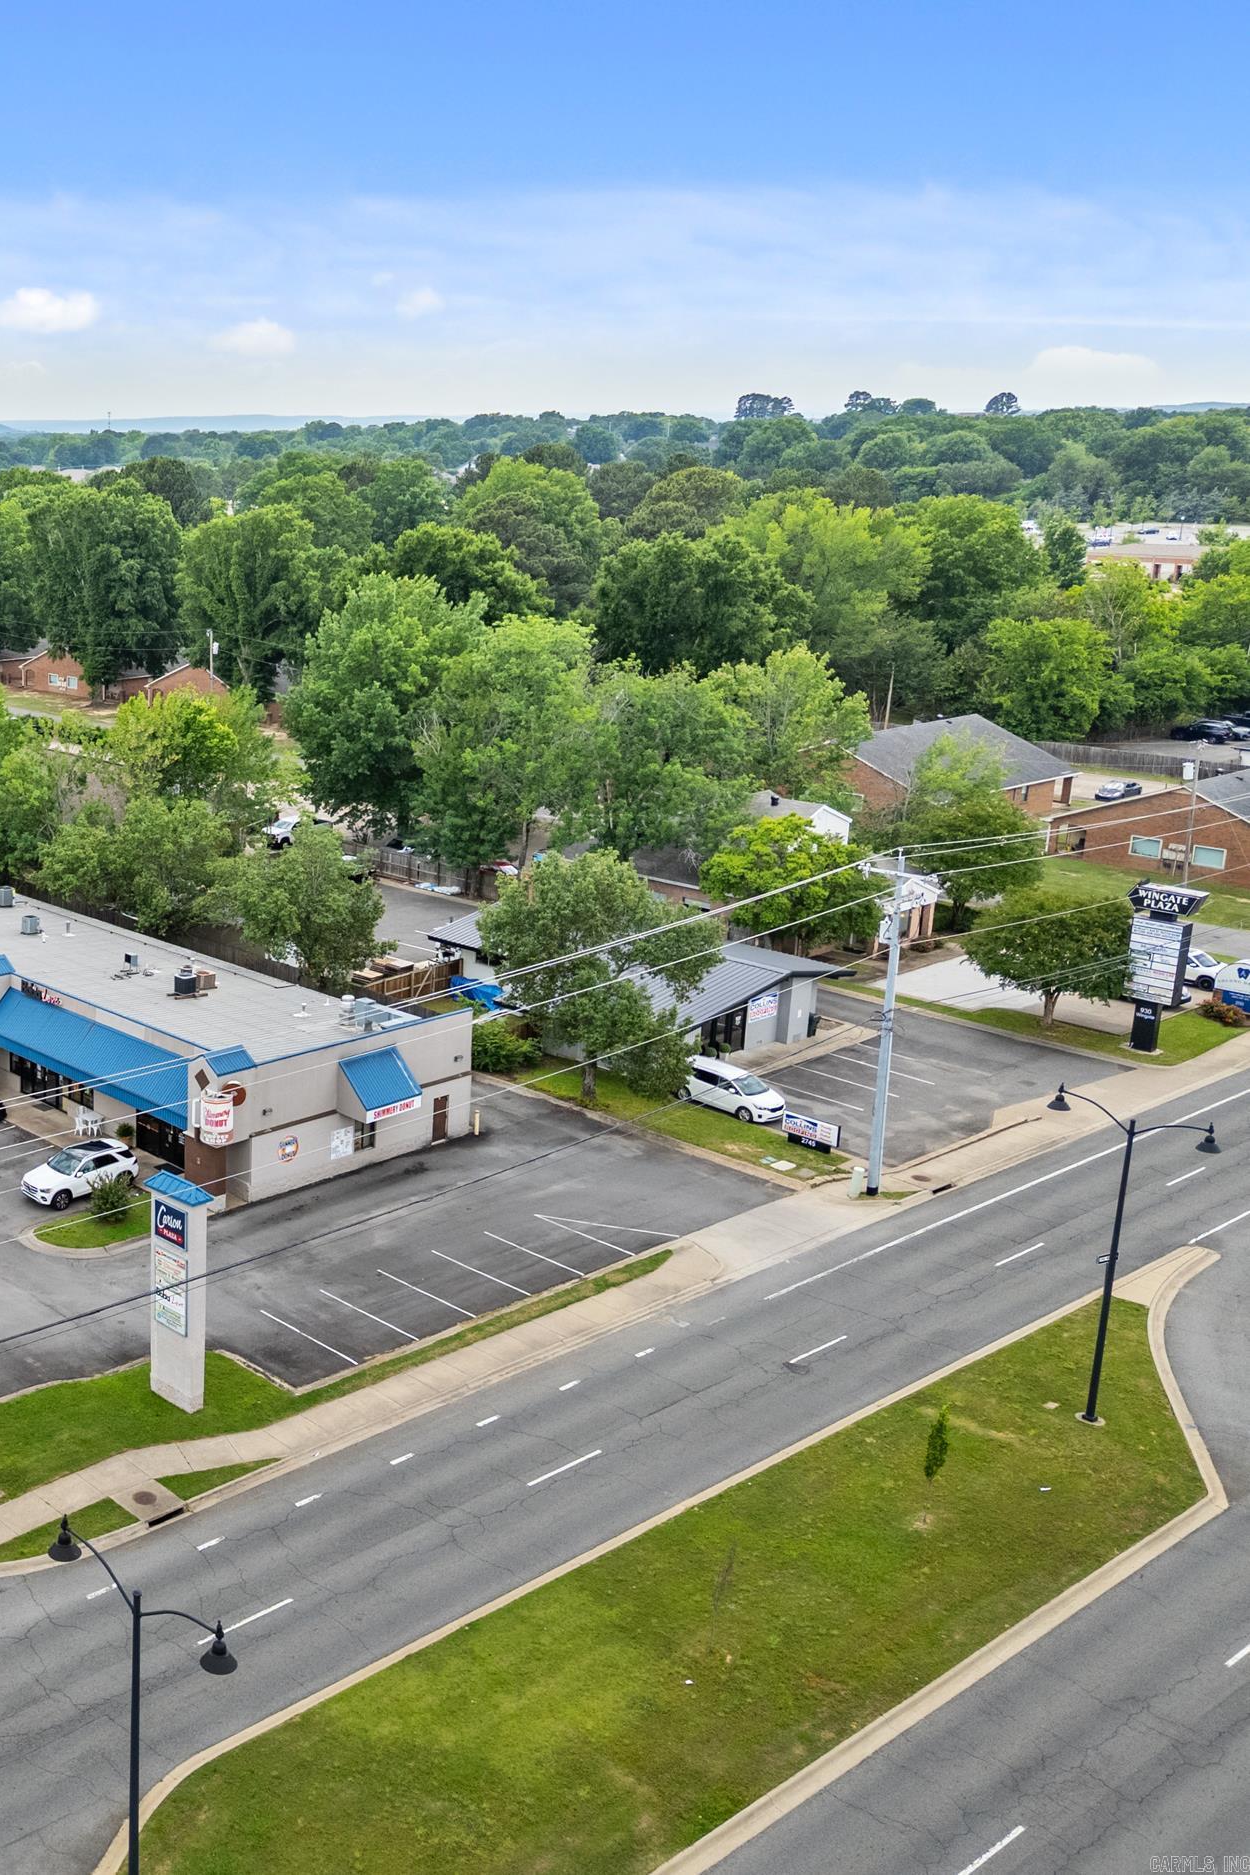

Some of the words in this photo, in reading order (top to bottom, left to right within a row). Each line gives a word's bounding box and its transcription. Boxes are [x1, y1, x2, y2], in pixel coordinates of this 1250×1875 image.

[1138, 889, 1190, 906] WINGATE
[1143, 898, 1180, 912] PLAZA
[399, 1099, 415, 1112] DONUT
[205, 1118, 228, 1127] DONUT
[157, 1205, 183, 1231] Carson
